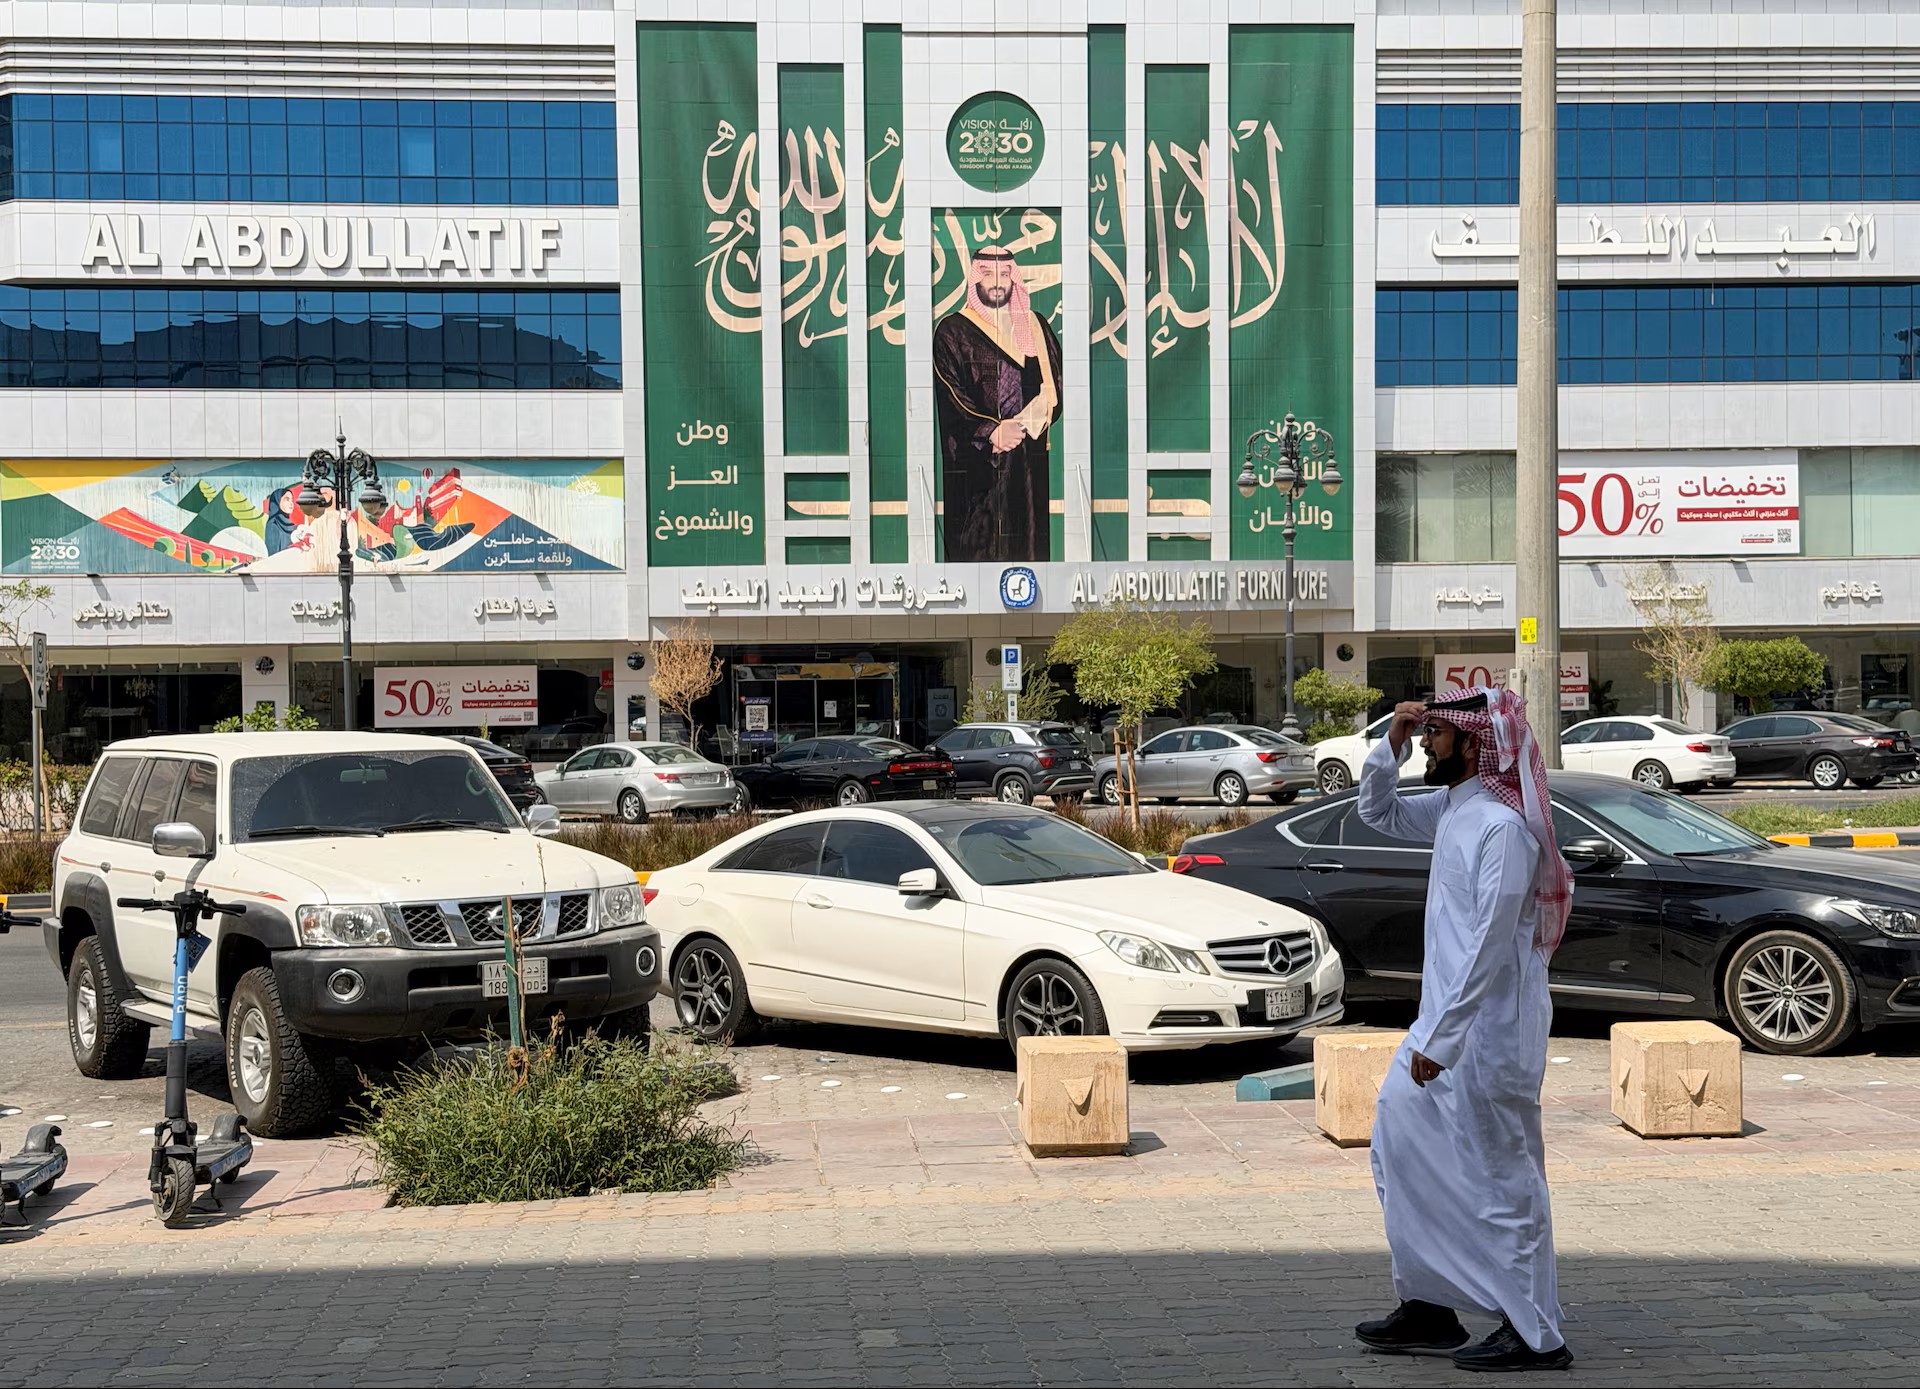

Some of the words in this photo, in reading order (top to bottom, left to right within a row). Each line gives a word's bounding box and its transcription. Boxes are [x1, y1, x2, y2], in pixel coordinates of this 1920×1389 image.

[960, 119, 996, 129] VISION
[81, 214, 159, 267] AL
[182, 215, 560, 271] ABDULLATIF
[1432, 212, 1688, 258] اللطف
[1695, 213, 1876, 270] العبد
[676, 420, 729, 446] وطن
[667, 465, 738, 491] العز
[1258, 456, 1323, 488] الأن
[1637, 476, 1660, 486] تصل
[1678, 475, 1787, 504] تخفيضات
[655, 508, 753, 541] والشموخ
[483, 532, 535, 548] حاملين
[484, 552, 535, 567] سائرين
[537, 551, 573, 566] وللقمة
[682, 578, 769, 611] اللطيف
[778, 577, 845, 610] العبد
[856, 573, 965, 609] مفروشات
[1073, 571, 1098, 602] AL
[1112, 570, 1226, 602] ABDULLATIF
[1850, 580, 1882, 602] غرف
[74, 601, 124, 622] وديكور
[127, 600, 169, 621] ستائر
[472, 596, 519, 618] أطفال
[521, 597, 555, 618] غرف
[1007, 650, 1016, 662] P
[384, 679, 453, 717] 50%
[461, 680, 530, 698] تخفيضات
